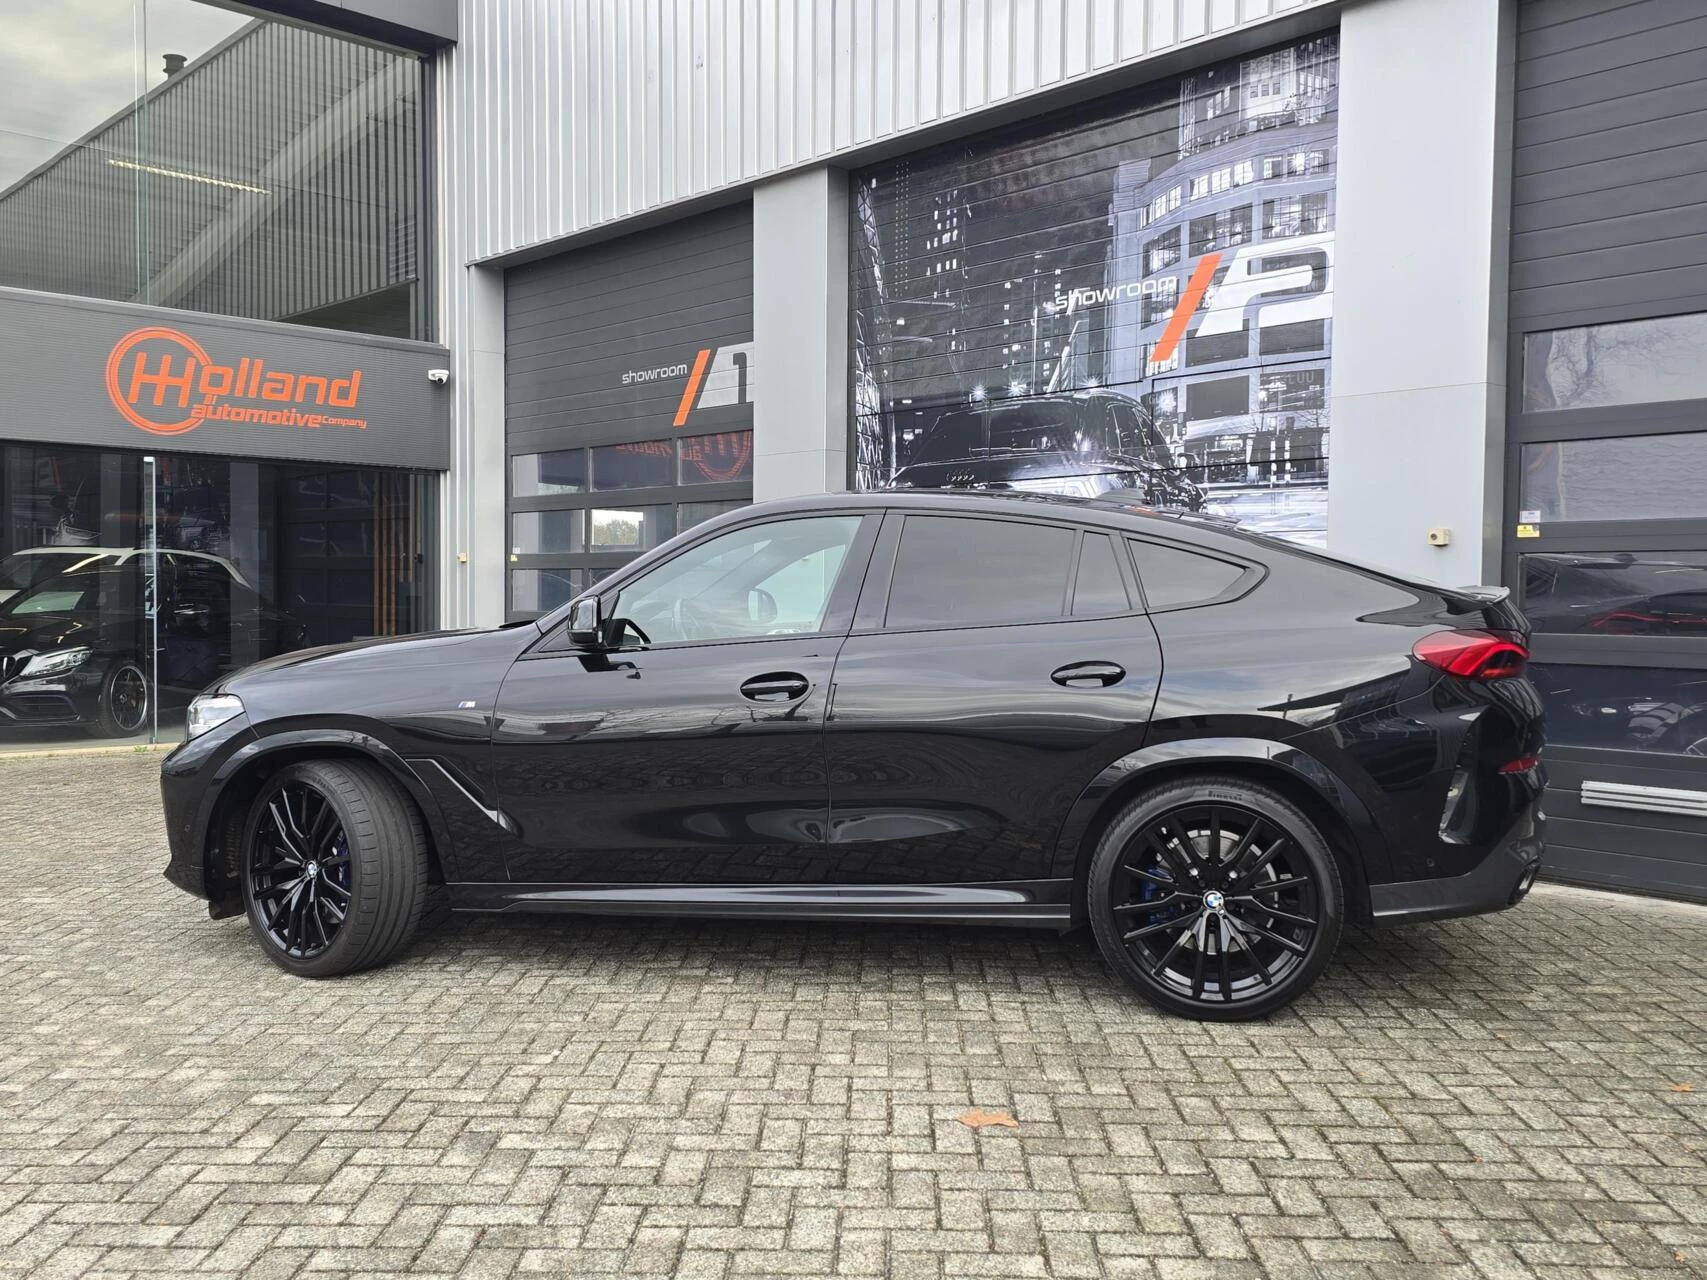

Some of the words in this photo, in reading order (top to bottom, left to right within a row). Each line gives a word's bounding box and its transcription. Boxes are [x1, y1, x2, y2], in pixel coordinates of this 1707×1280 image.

[1056, 275, 1178, 310] showroom
[623, 363, 688, 384] showroom
[191, 403, 322, 428] automotive
[323, 415, 368, 429] Company
